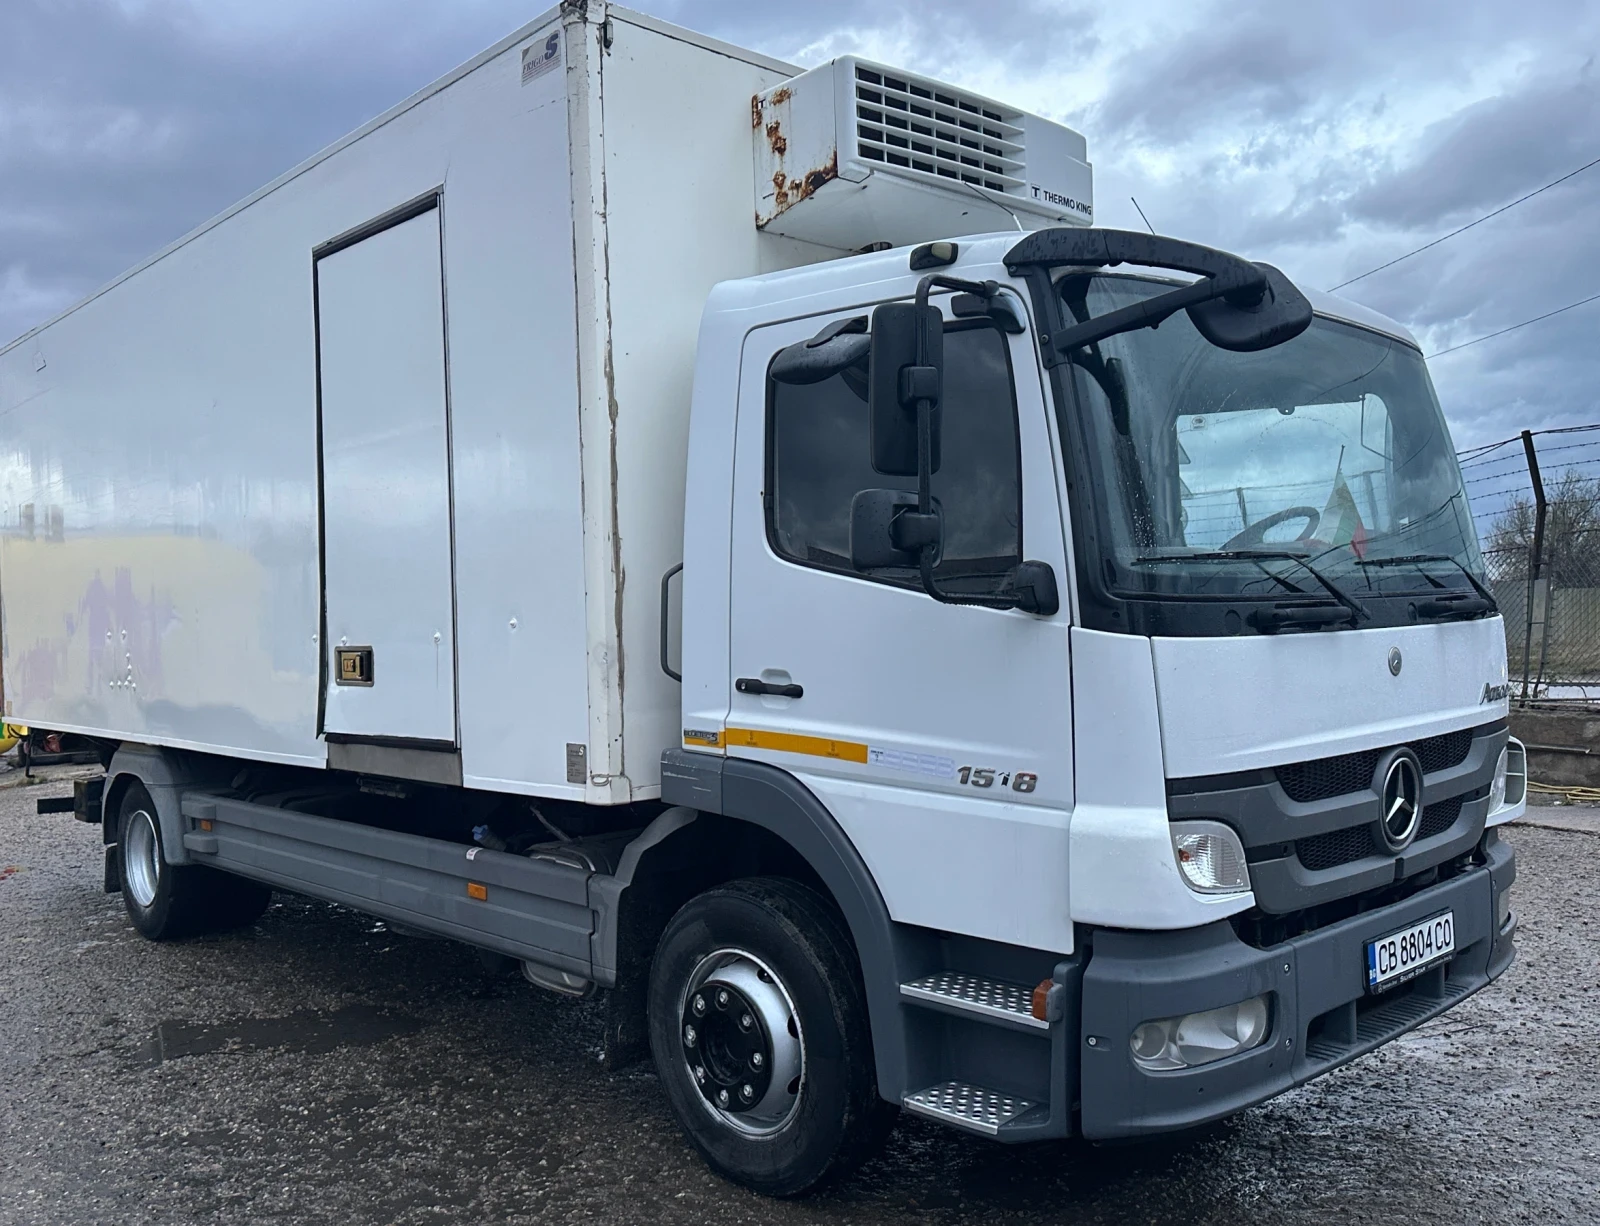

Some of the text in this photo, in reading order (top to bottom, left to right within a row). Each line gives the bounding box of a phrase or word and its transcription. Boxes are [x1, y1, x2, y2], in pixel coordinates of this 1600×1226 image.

[522, 54, 544, 74] FRIGO
[544, 33, 559, 60] S
[1031, 186, 1092, 216] T THERMO KING
[957, 765, 1038, 793] 1518
[1378, 940, 1398, 974] CB
[1400, 925, 1433, 966] 8804
[1434, 918, 1452, 951] CO
